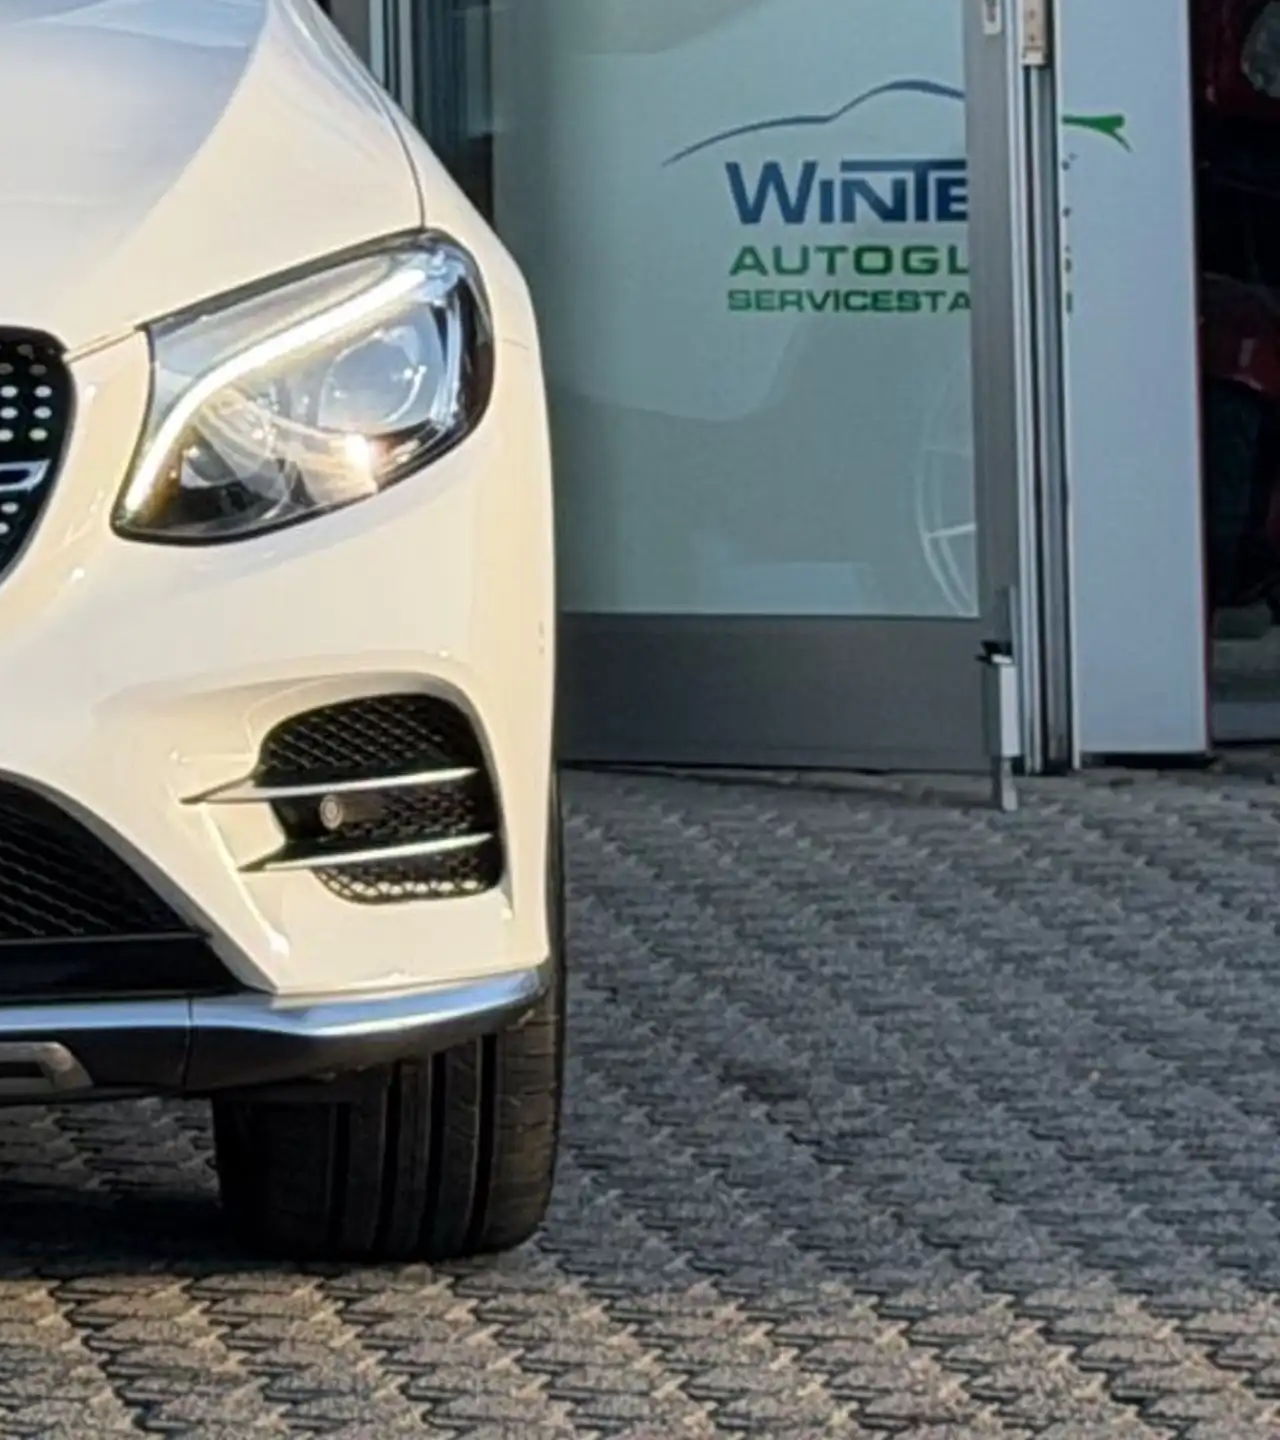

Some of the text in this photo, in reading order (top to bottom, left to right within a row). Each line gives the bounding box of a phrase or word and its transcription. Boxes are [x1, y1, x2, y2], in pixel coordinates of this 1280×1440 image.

[725, 158, 1072, 225] WINTE
[729, 244, 1072, 276] AUTOGL
[727, 288, 1073, 313] SERVICESTA
